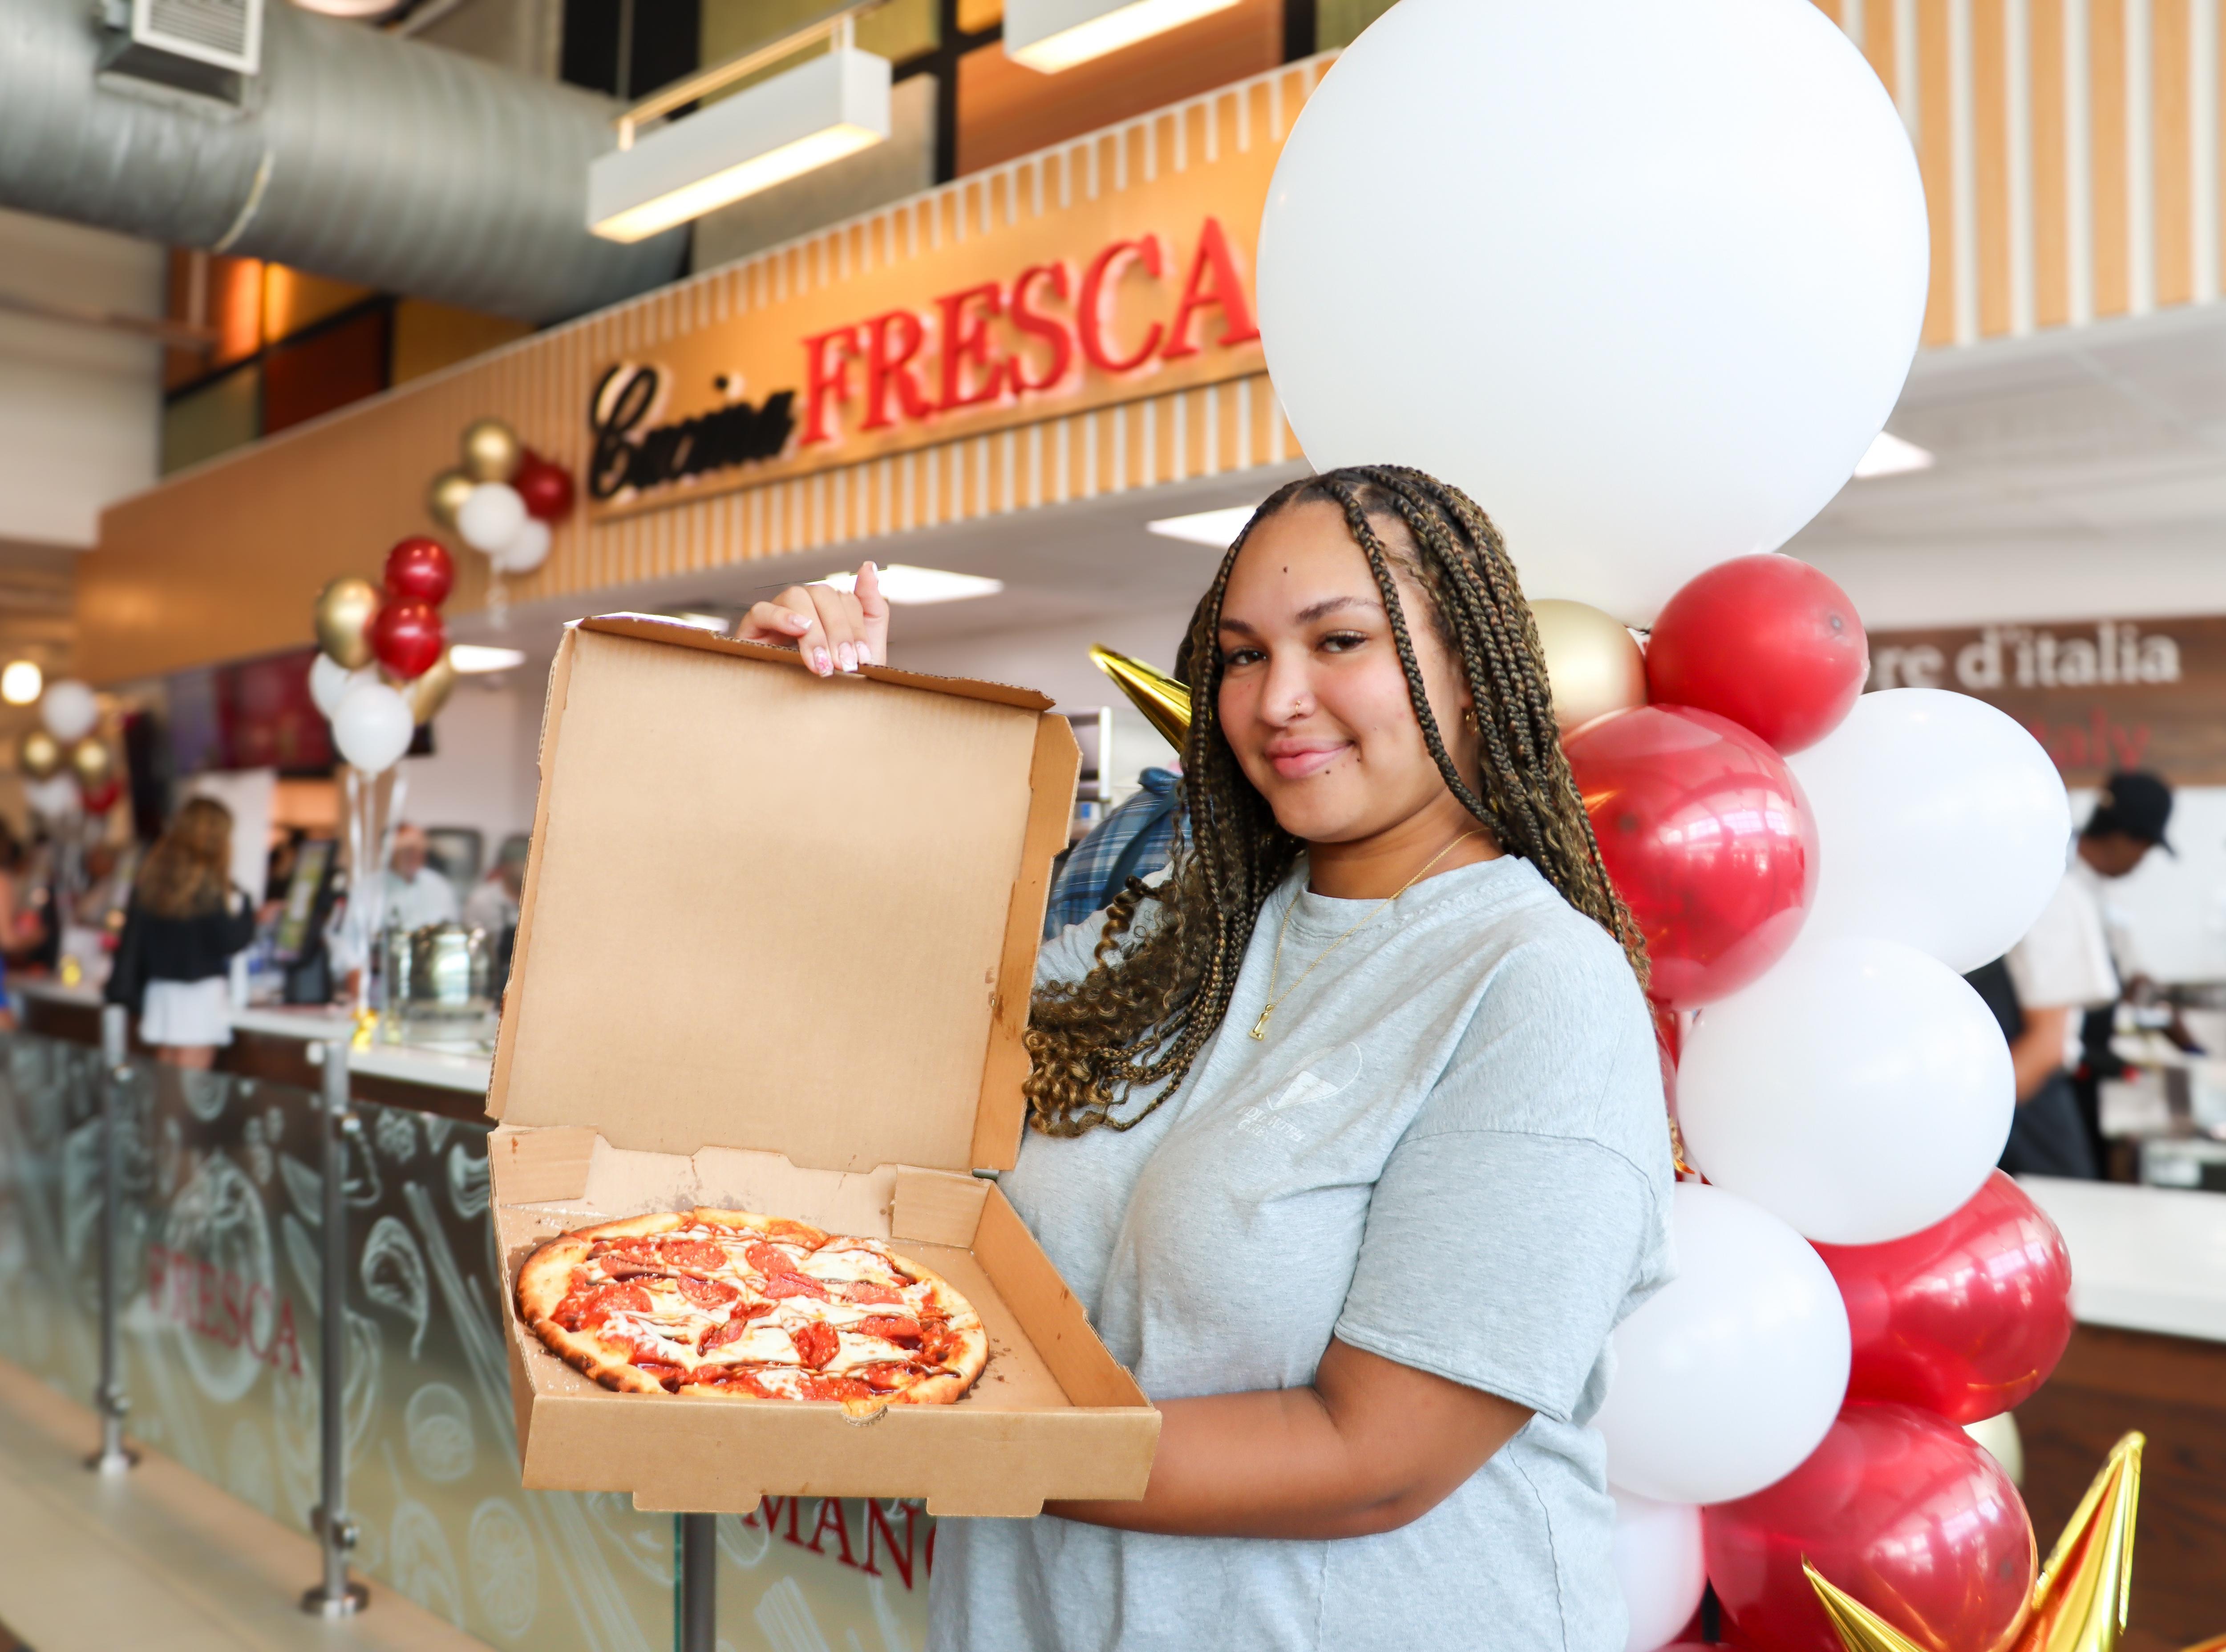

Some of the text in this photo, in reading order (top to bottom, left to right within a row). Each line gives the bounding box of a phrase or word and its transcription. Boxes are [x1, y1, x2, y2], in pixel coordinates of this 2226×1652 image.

[800, 215, 1260, 446] FRESCA
[1874, 619, 2181, 690] re d'italia
[148, 1243, 303, 1378] FRESCA
[742, 1494, 935, 1591] MAN
